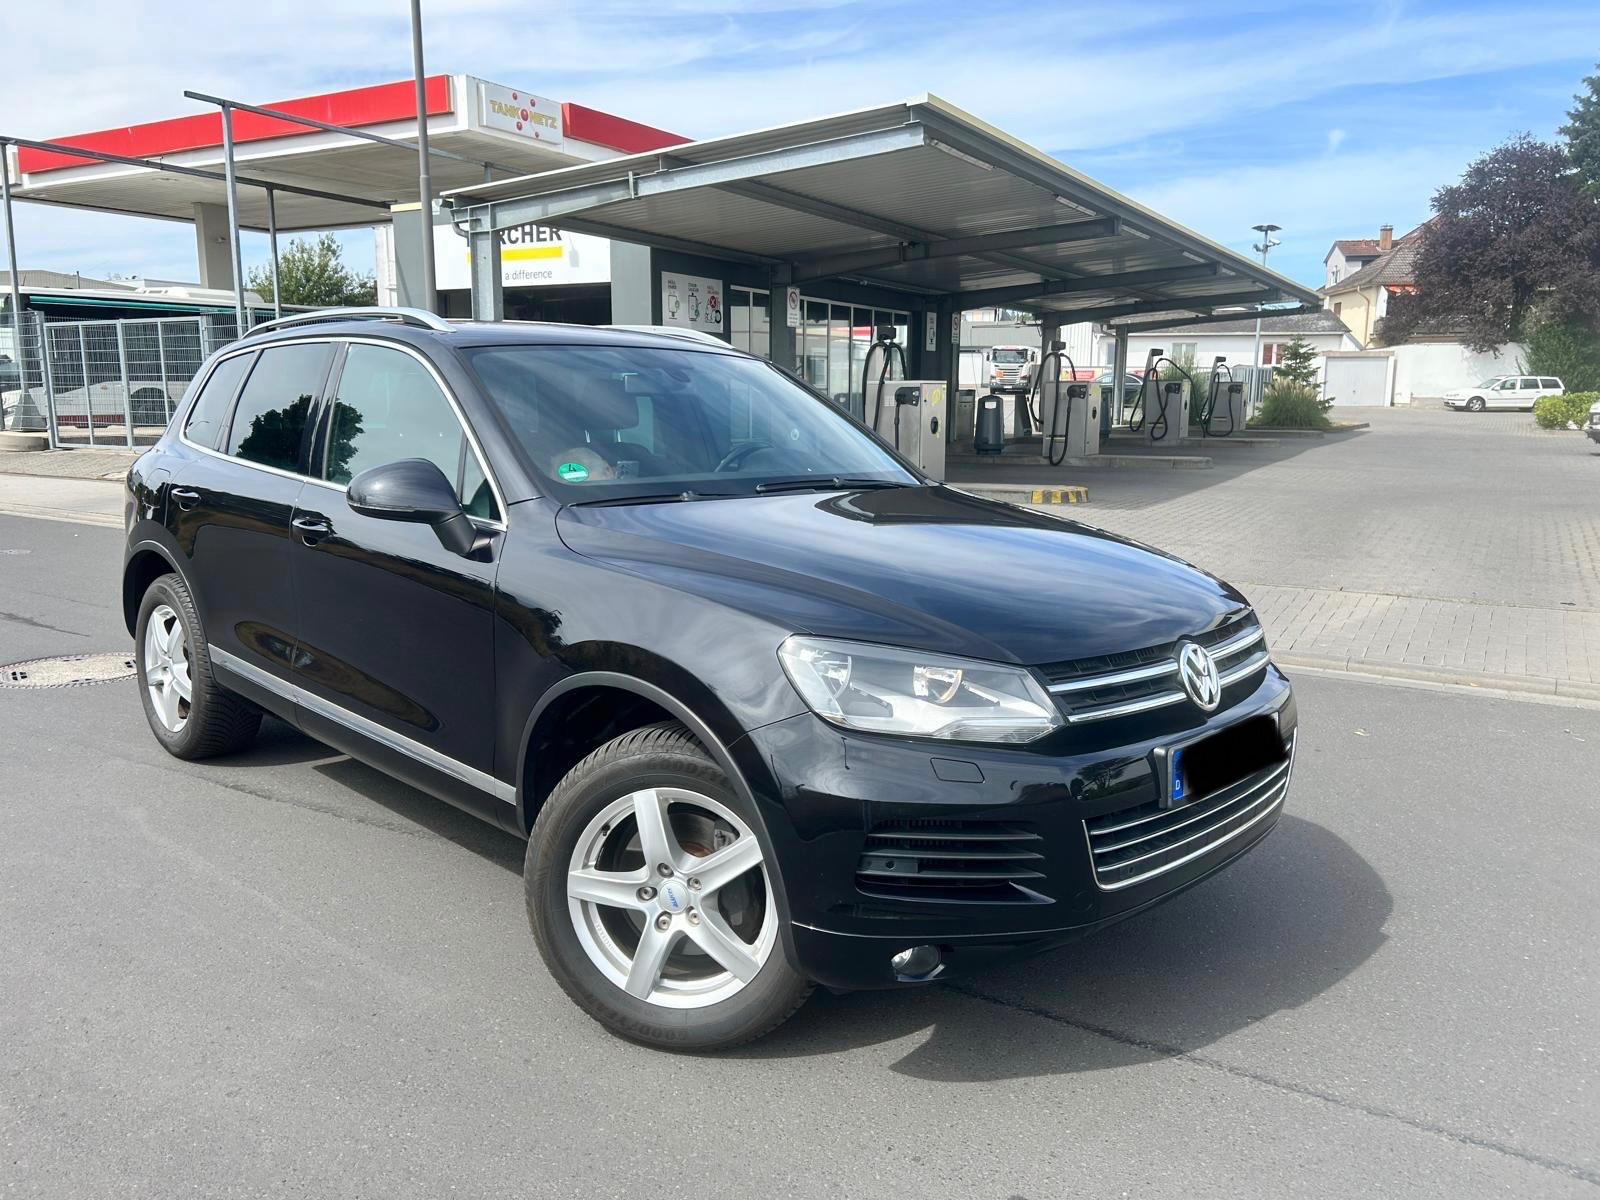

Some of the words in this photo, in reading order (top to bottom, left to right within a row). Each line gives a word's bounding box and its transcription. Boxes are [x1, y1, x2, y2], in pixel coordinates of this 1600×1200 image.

[489, 100, 521, 119] TANK
[528, 110, 557, 129] NETZ
[498, 224, 562, 245] RCHER
[504, 273, 510, 281] a
[511, 269, 553, 280] difference
[1175, 779, 1181, 791] D
